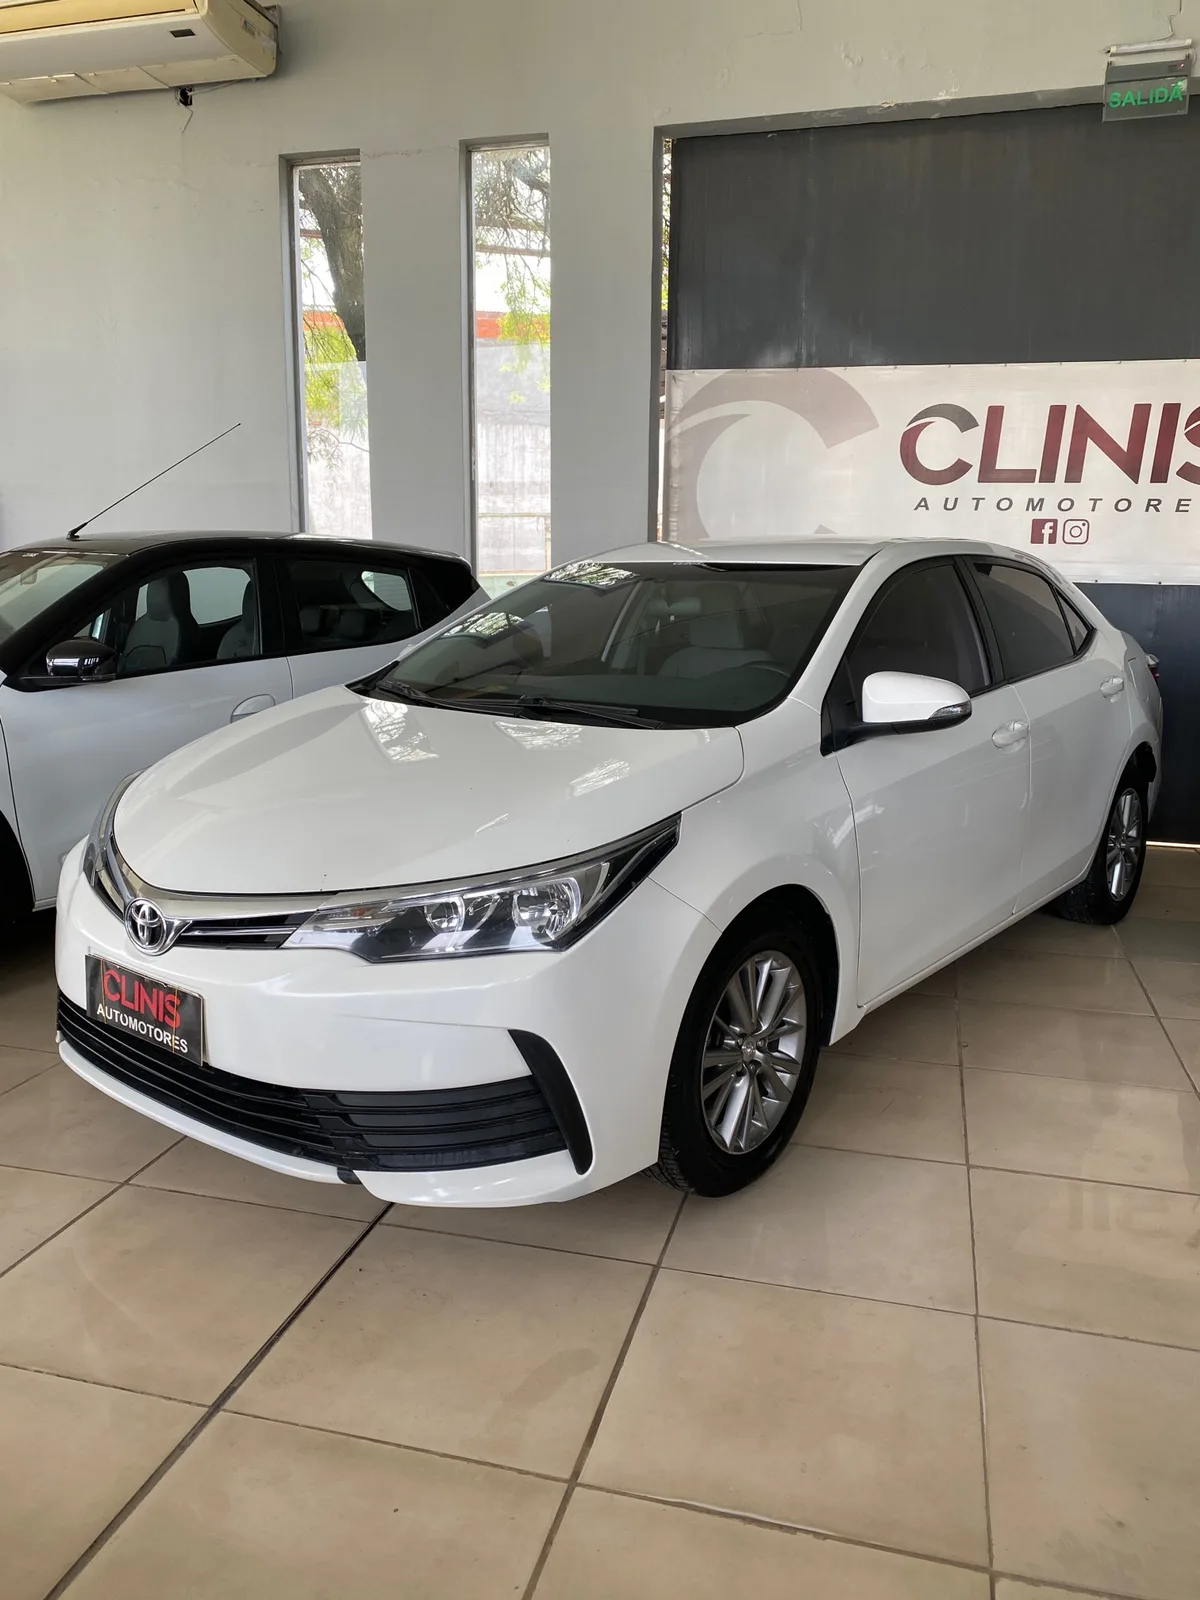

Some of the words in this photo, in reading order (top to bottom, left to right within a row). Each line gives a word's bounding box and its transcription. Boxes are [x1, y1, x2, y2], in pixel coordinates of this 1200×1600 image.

[1109, 85, 1183, 108] SALIDA
[914, 497, 1192, 513] AUTOMOTORE
[103, 969, 181, 1029] CLINIS
[96, 1003, 189, 1054] AUTOMOTORES
